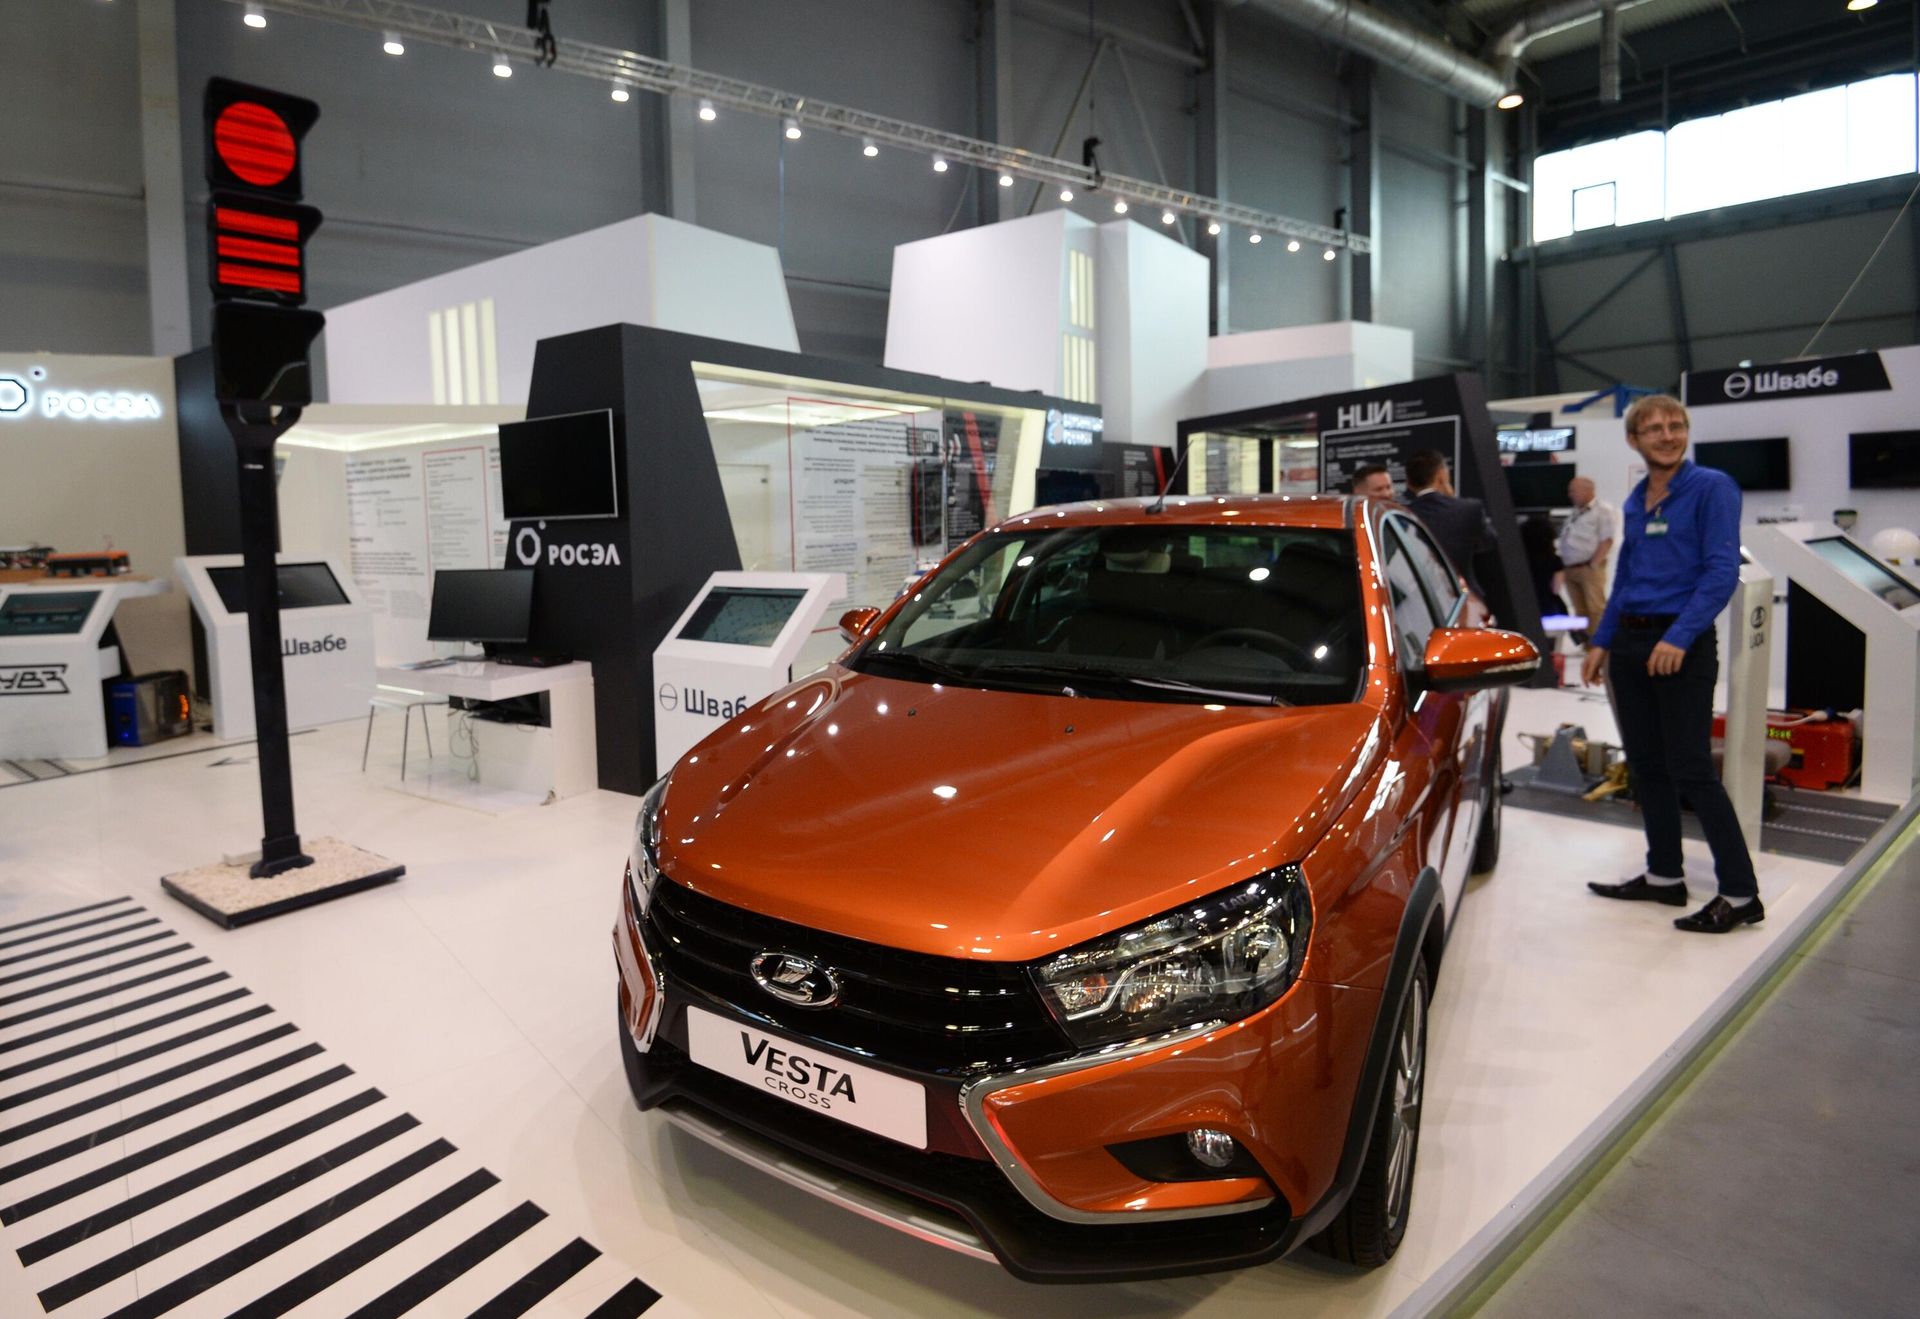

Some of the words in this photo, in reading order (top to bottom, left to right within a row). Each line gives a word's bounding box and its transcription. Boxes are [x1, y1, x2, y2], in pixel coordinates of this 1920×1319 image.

[1754, 366, 1839, 393] Швабе
[548, 543, 621, 566] РОСЭЛ
[280, 634, 347, 656] Швабе
[684, 687, 747, 719] Шваб
[740, 1031, 856, 1104] VESTA
[764, 1076, 831, 1109] CROSS
